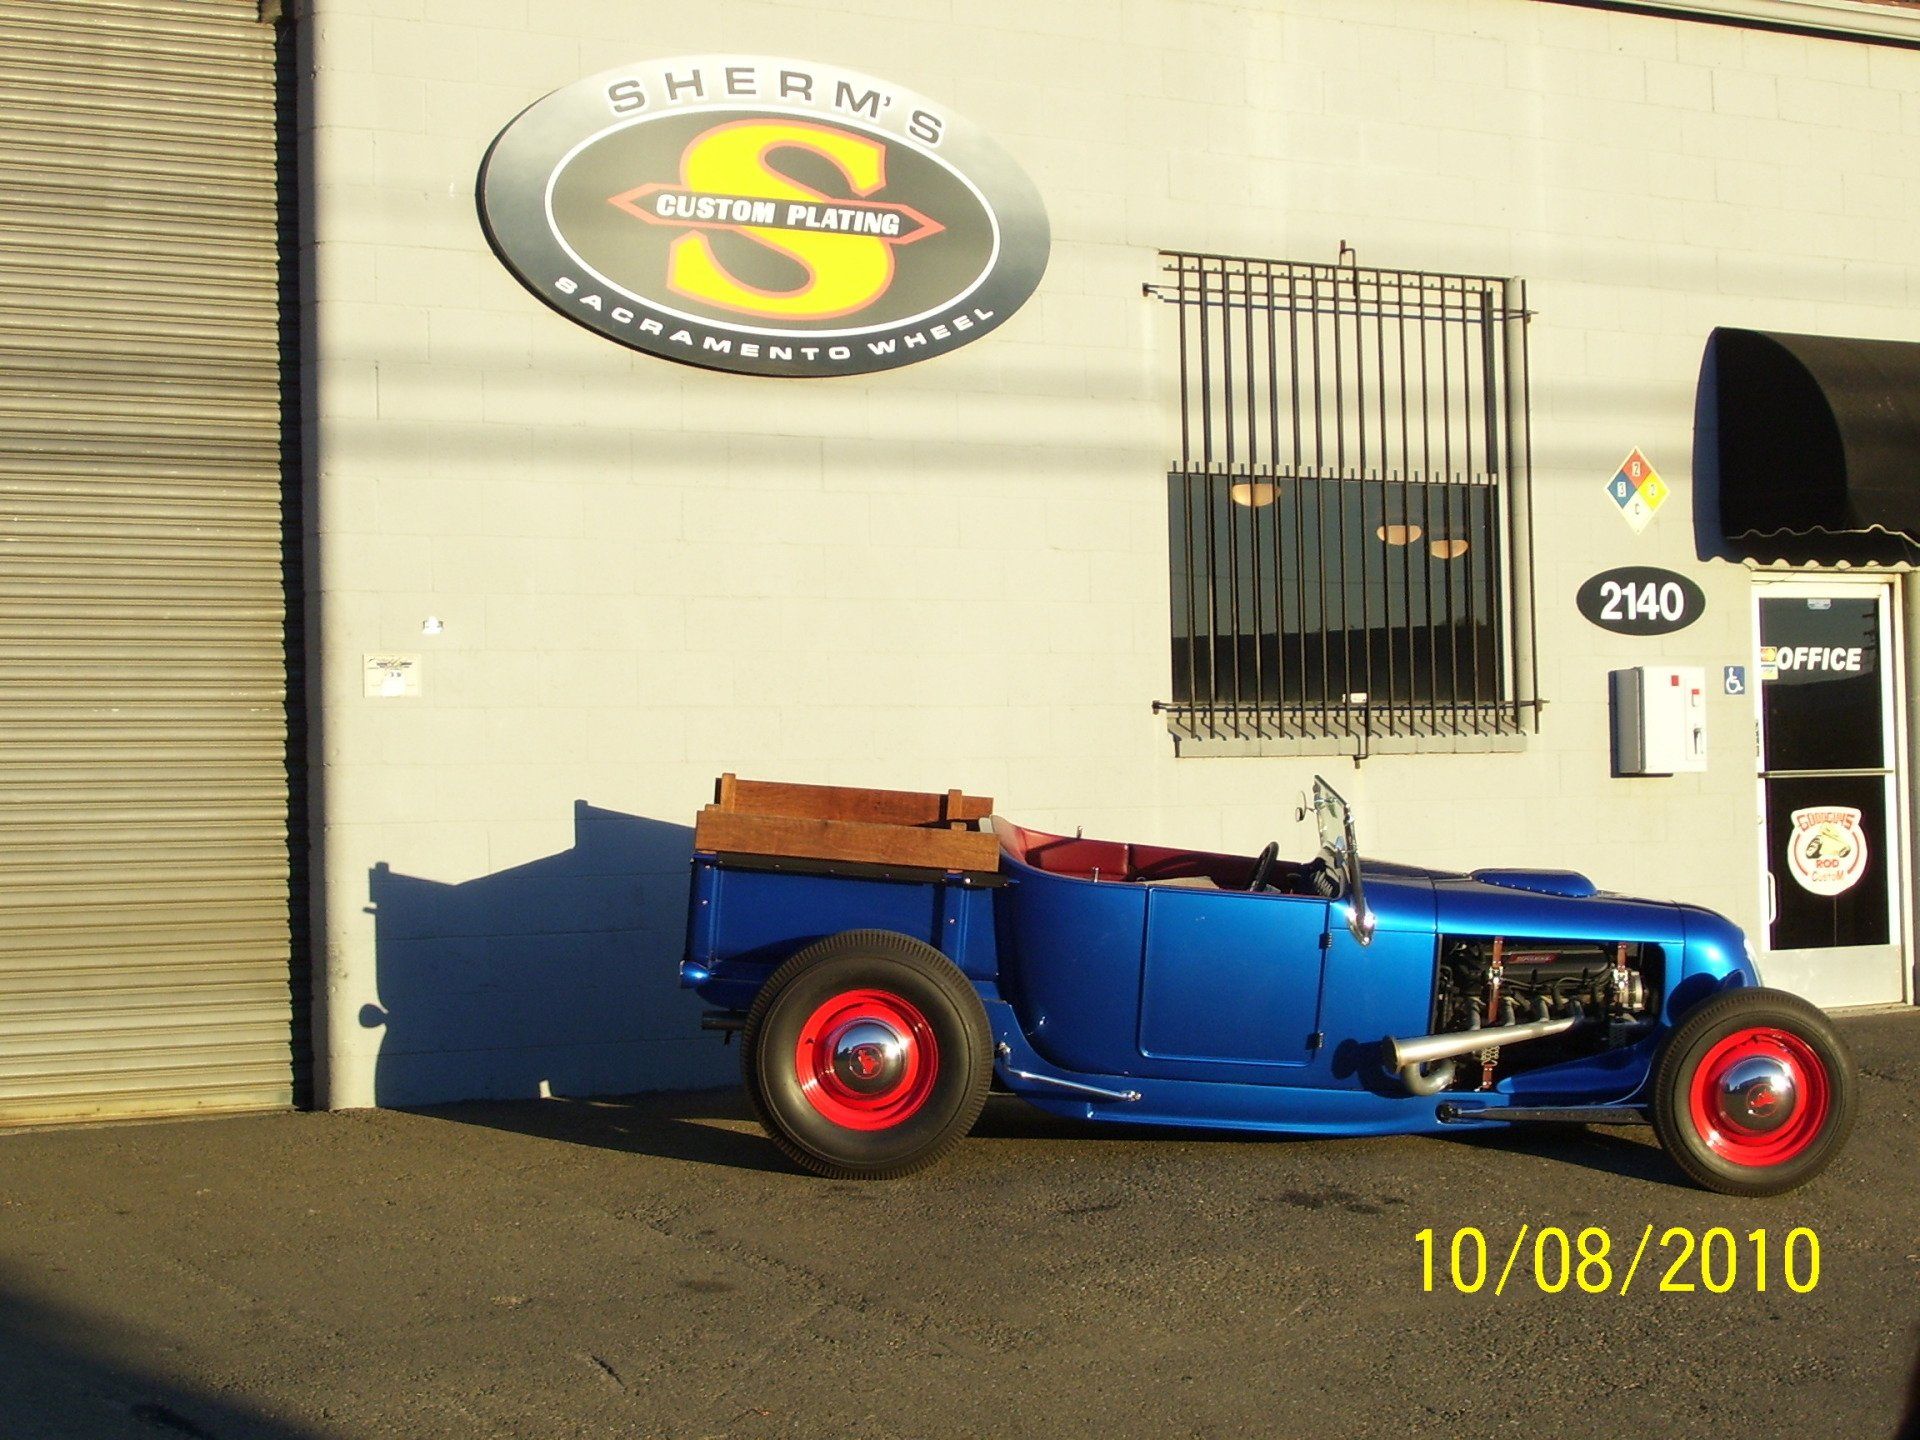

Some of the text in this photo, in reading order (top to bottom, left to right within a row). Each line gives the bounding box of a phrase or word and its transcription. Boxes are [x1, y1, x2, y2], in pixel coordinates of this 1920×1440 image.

[608, 66, 943, 144] SHERM'S
[655, 193, 901, 236] CUSTOM PLATING
[554, 275, 994, 361] SACRAMENTO WHEEL
[1600, 580, 1684, 621] 2140
[1775, 646, 1862, 671] OFFICE
[1816, 859, 1839, 868] ROD
